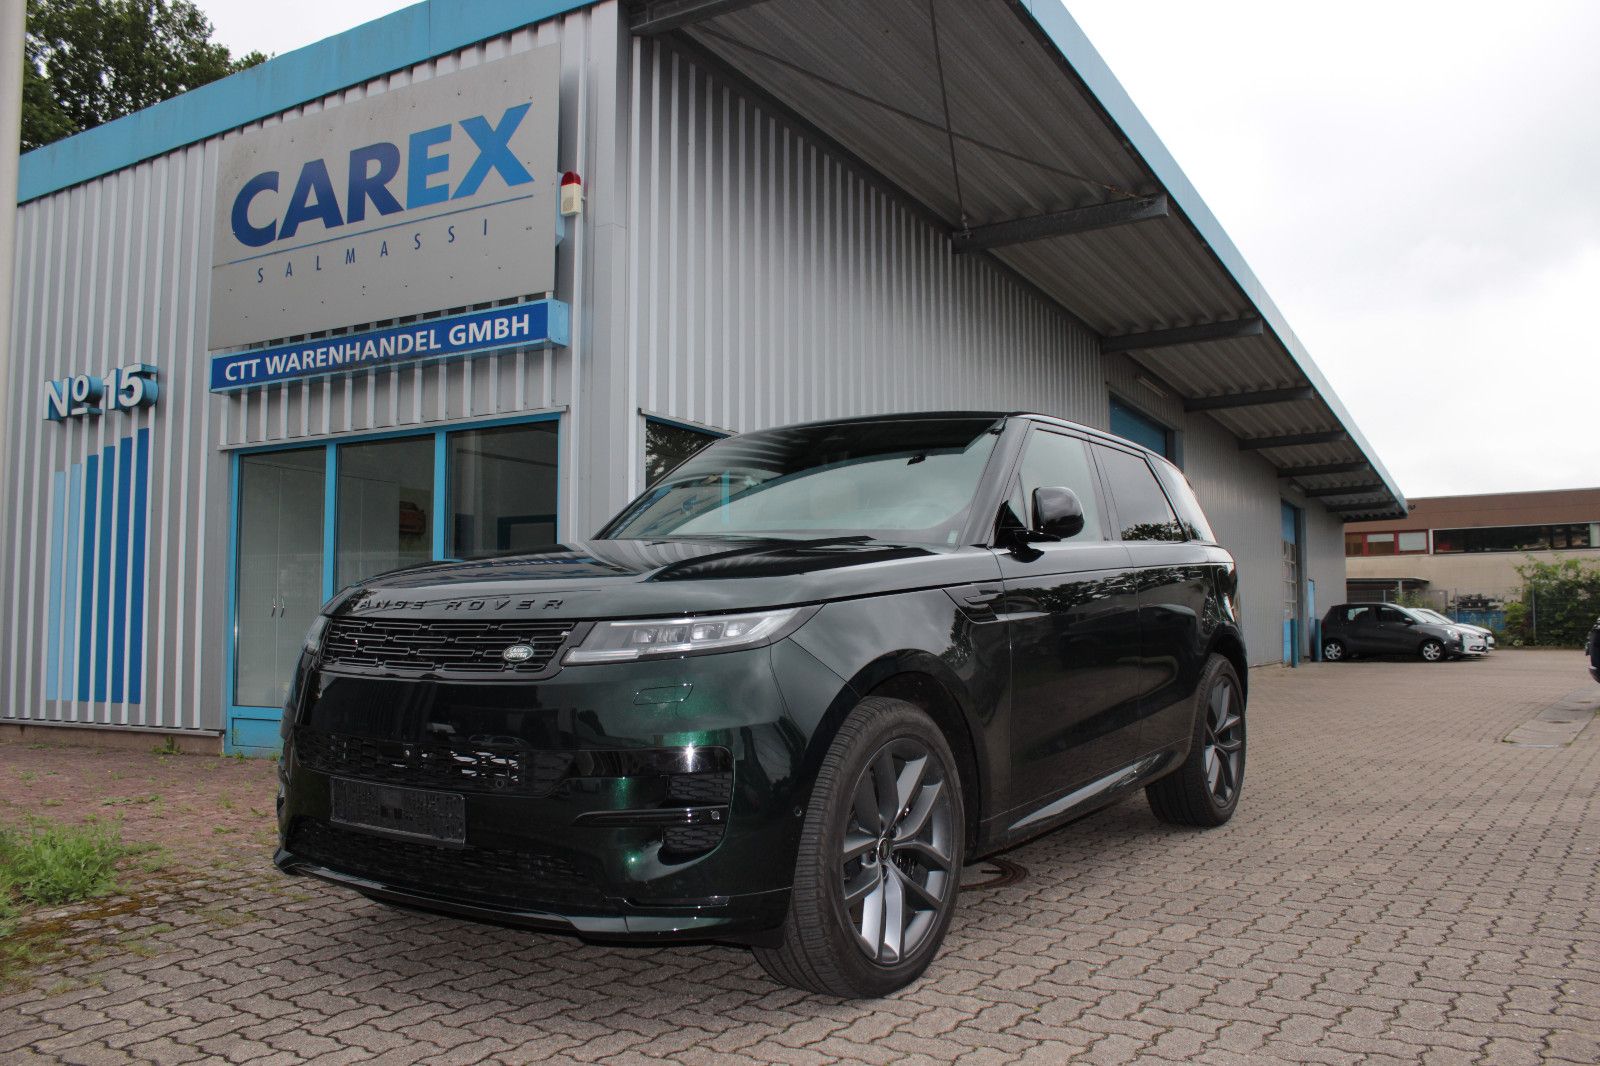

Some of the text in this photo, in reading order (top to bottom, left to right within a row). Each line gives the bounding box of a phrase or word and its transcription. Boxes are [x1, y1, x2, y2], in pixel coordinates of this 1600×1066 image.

[231, 101, 536, 248] CAREX
[257, 218, 488, 283] SALMASSI
[224, 313, 530, 382] CTT WARENHANDEL GMBH
[102, 362, 152, 411] 15
[444, 599, 564, 611] ROVER
